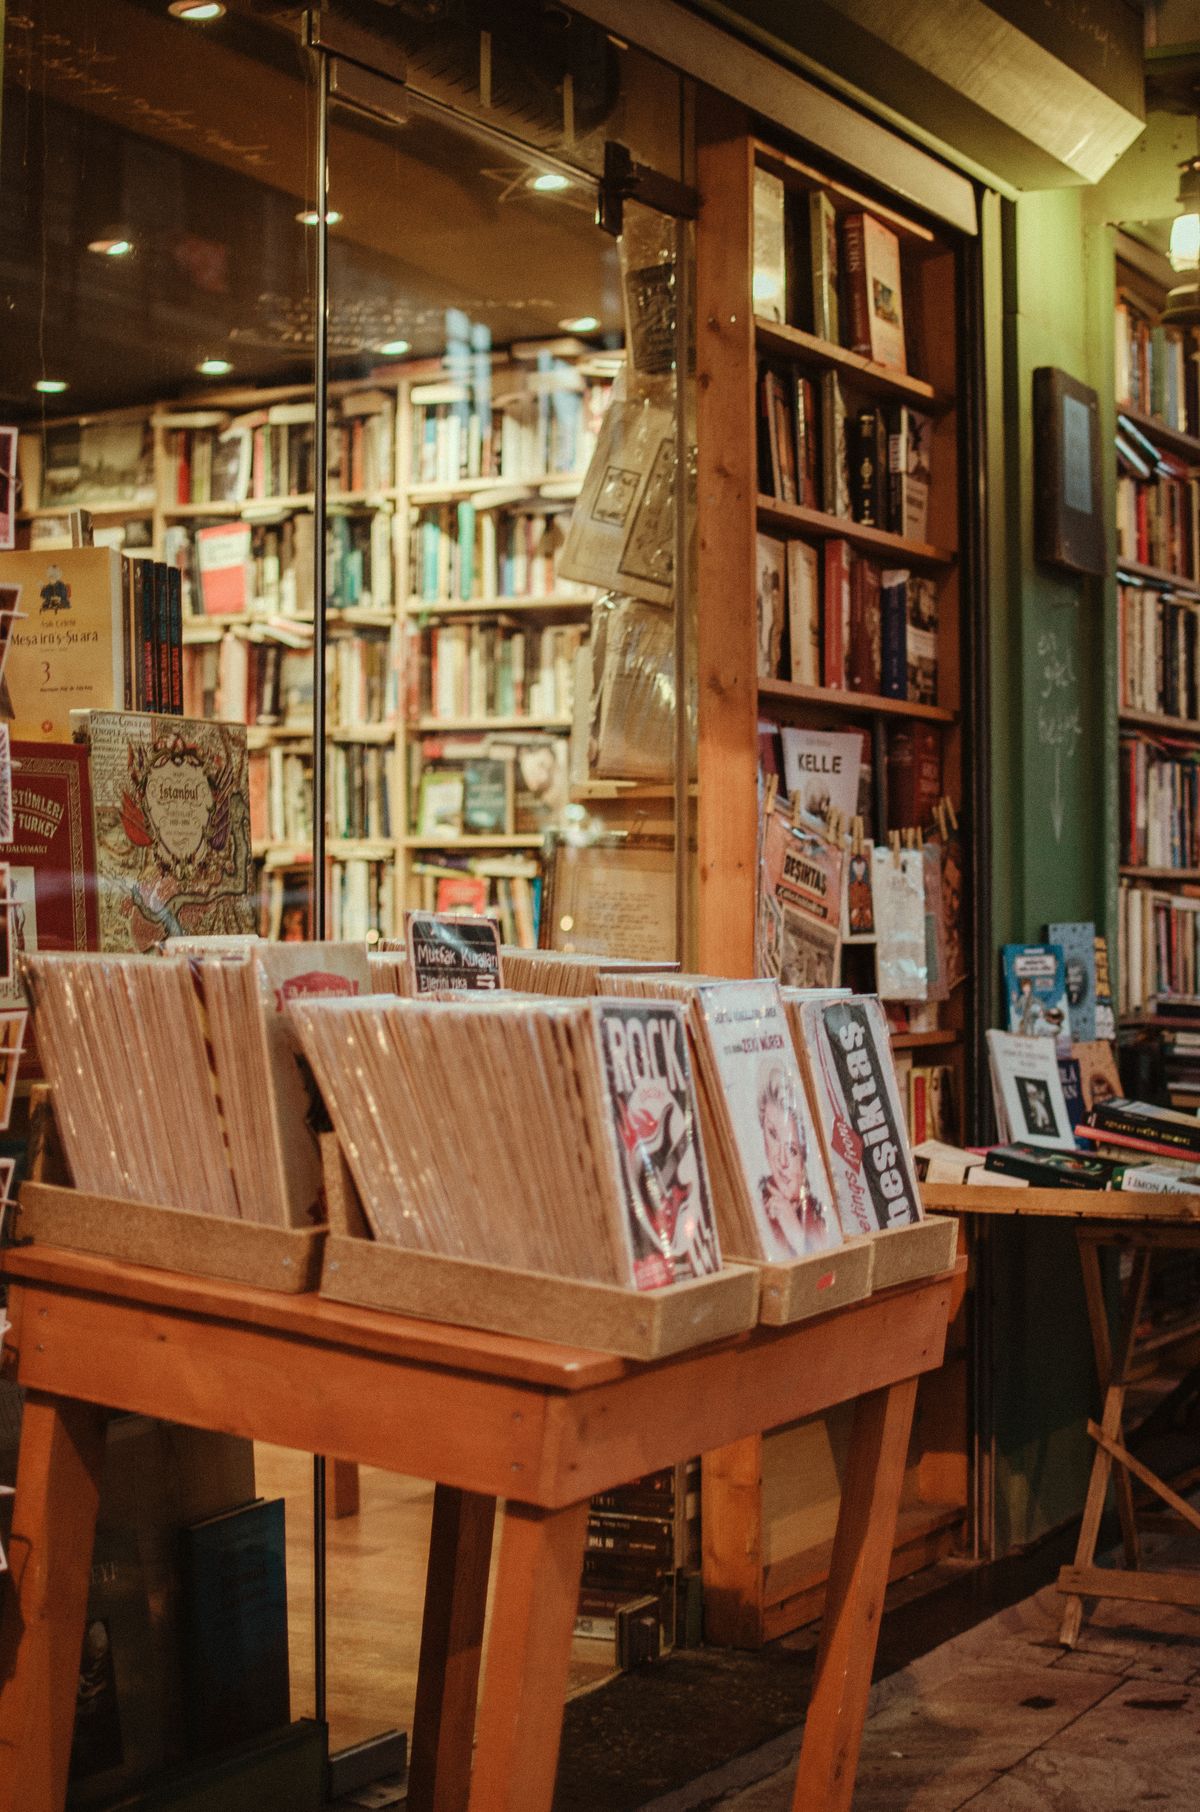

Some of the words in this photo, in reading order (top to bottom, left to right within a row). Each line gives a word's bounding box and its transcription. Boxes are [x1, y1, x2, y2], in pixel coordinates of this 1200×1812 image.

[41, 660, 51, 685] 3
[798, 753, 843, 775] KELLE
[18, 813, 58, 839] TURKEY
[417, 943, 457, 966] Mutfak
[602, 1016, 688, 1093] ROCK
[836, 1119, 862, 1168] from
[845, 1169, 871, 1233] etings
